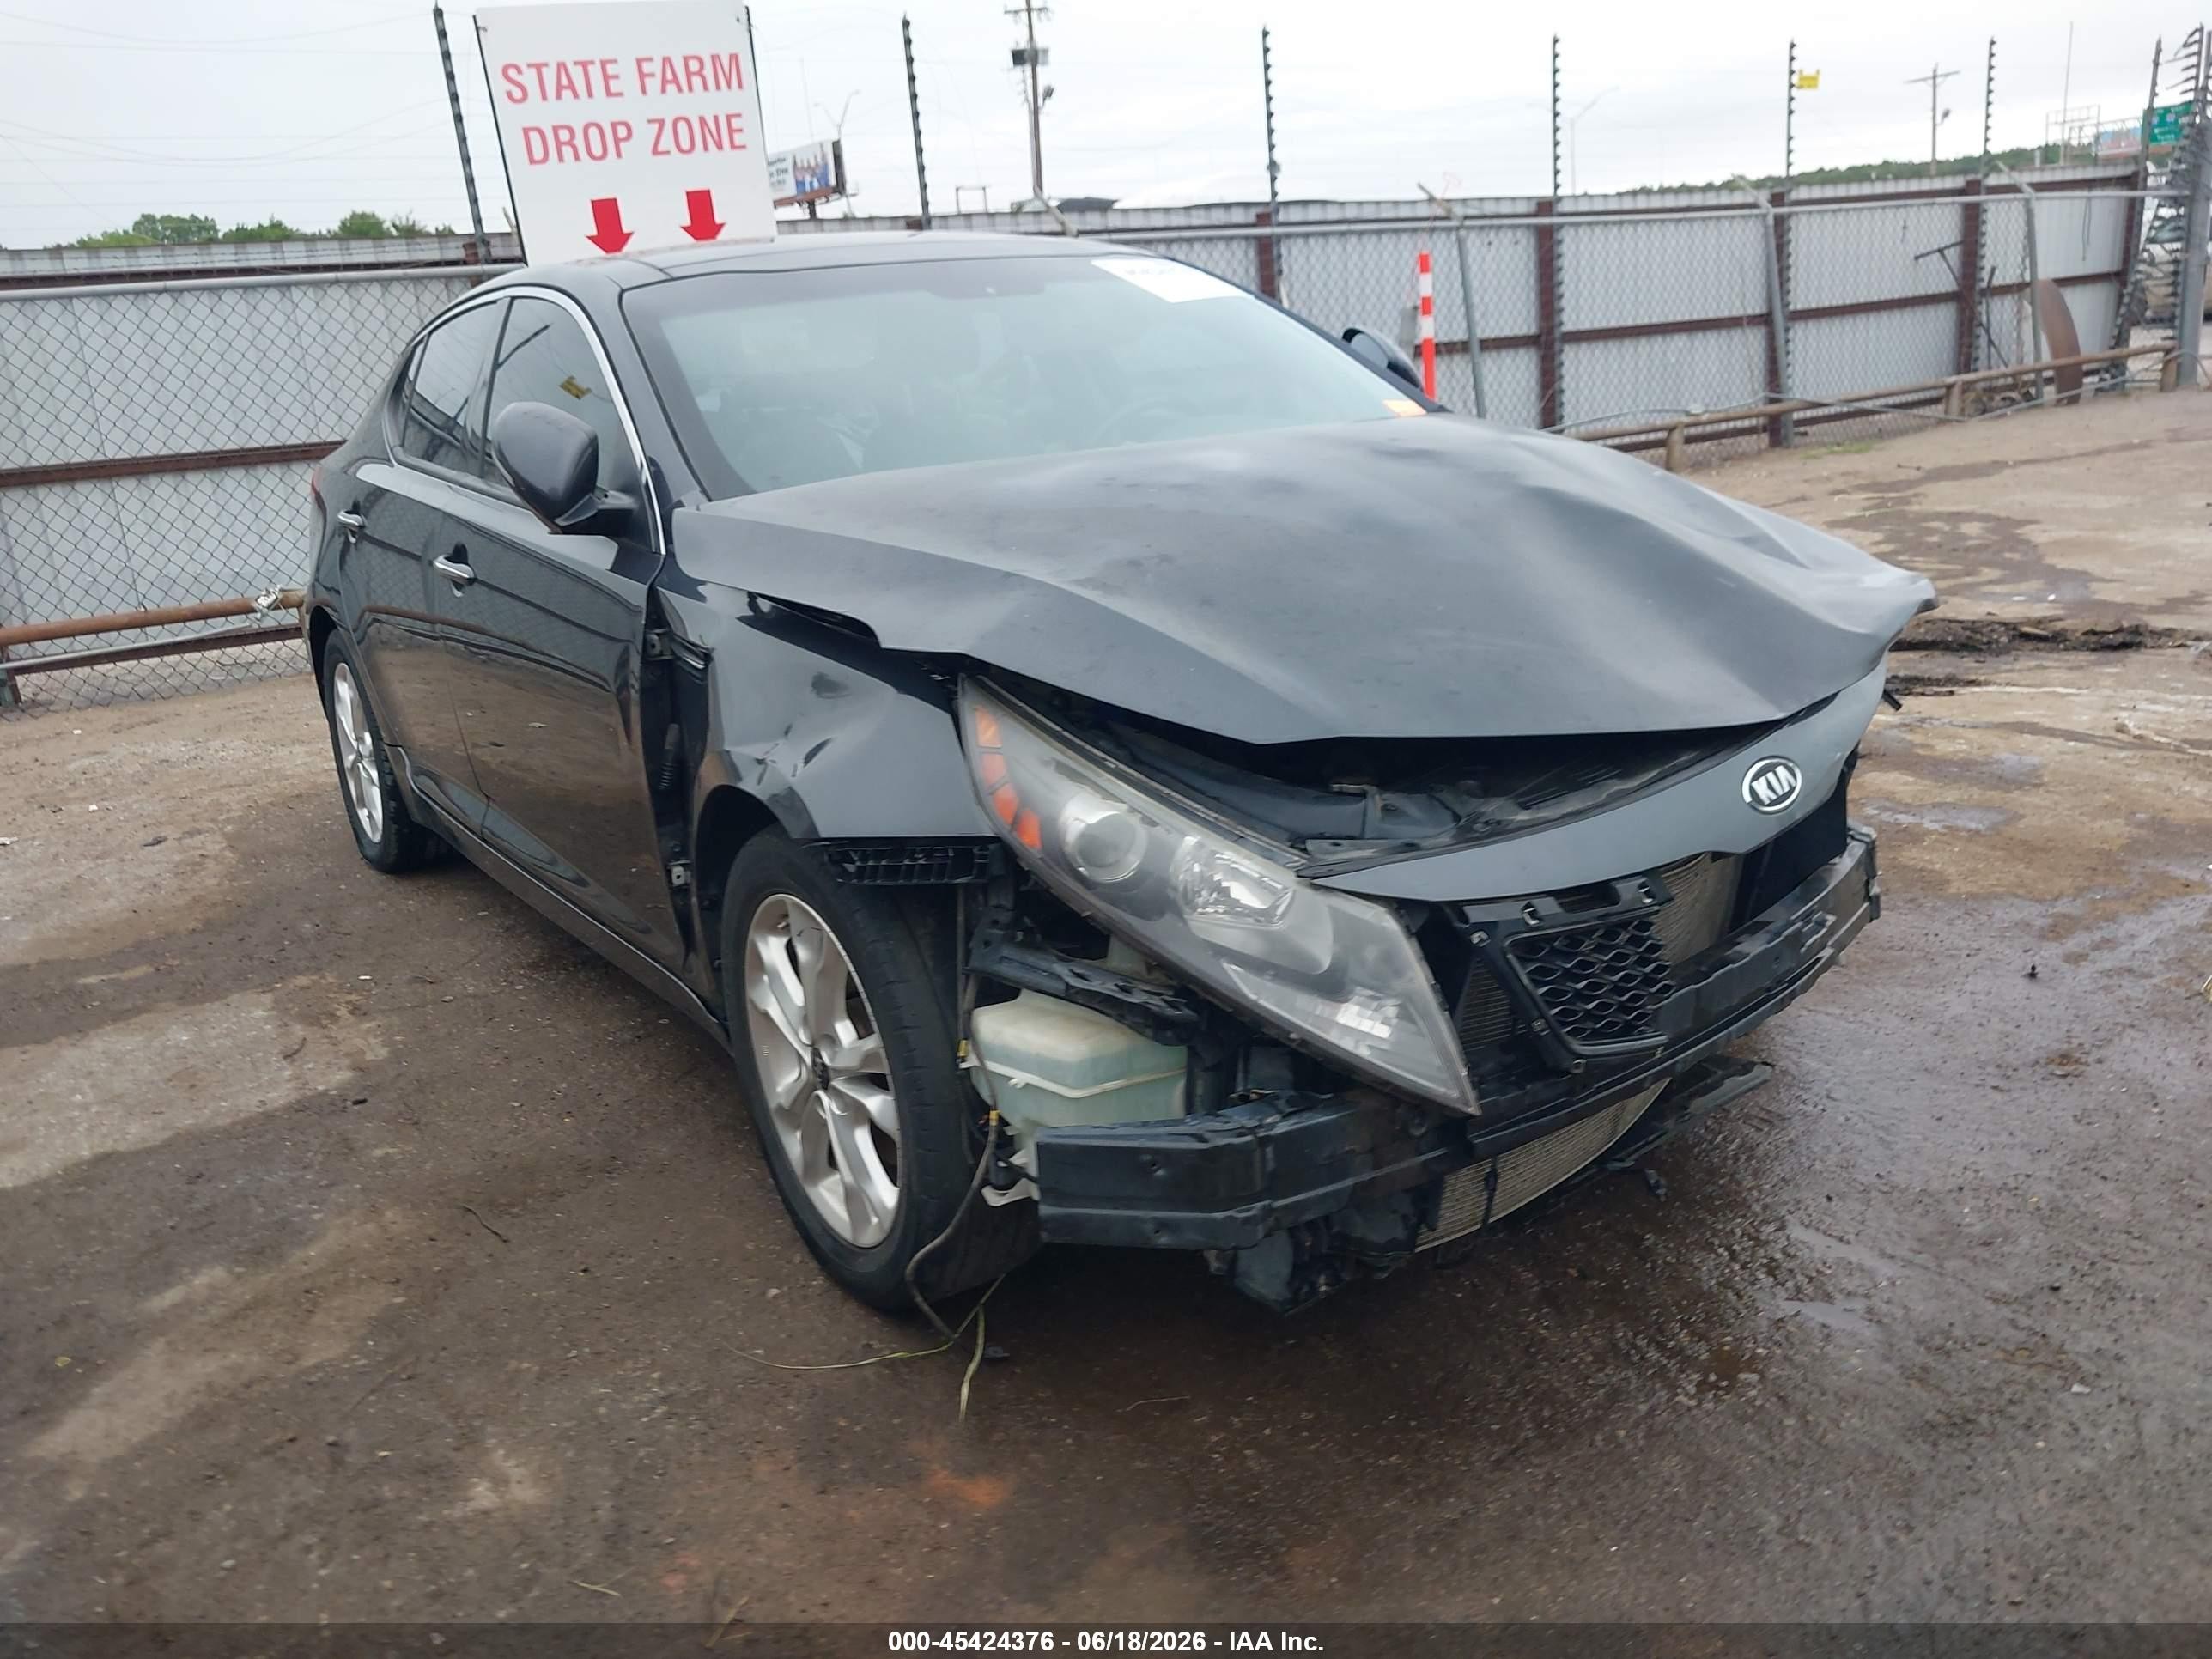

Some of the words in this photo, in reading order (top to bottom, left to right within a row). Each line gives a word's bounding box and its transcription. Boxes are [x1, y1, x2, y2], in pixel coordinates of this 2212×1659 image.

[501, 58, 623, 104] STATE
[635, 52, 744, 95] FARM
[522, 119, 633, 166] DROP
[647, 113, 746, 157] ZONE
[1751, 765, 1796, 805] KIA
